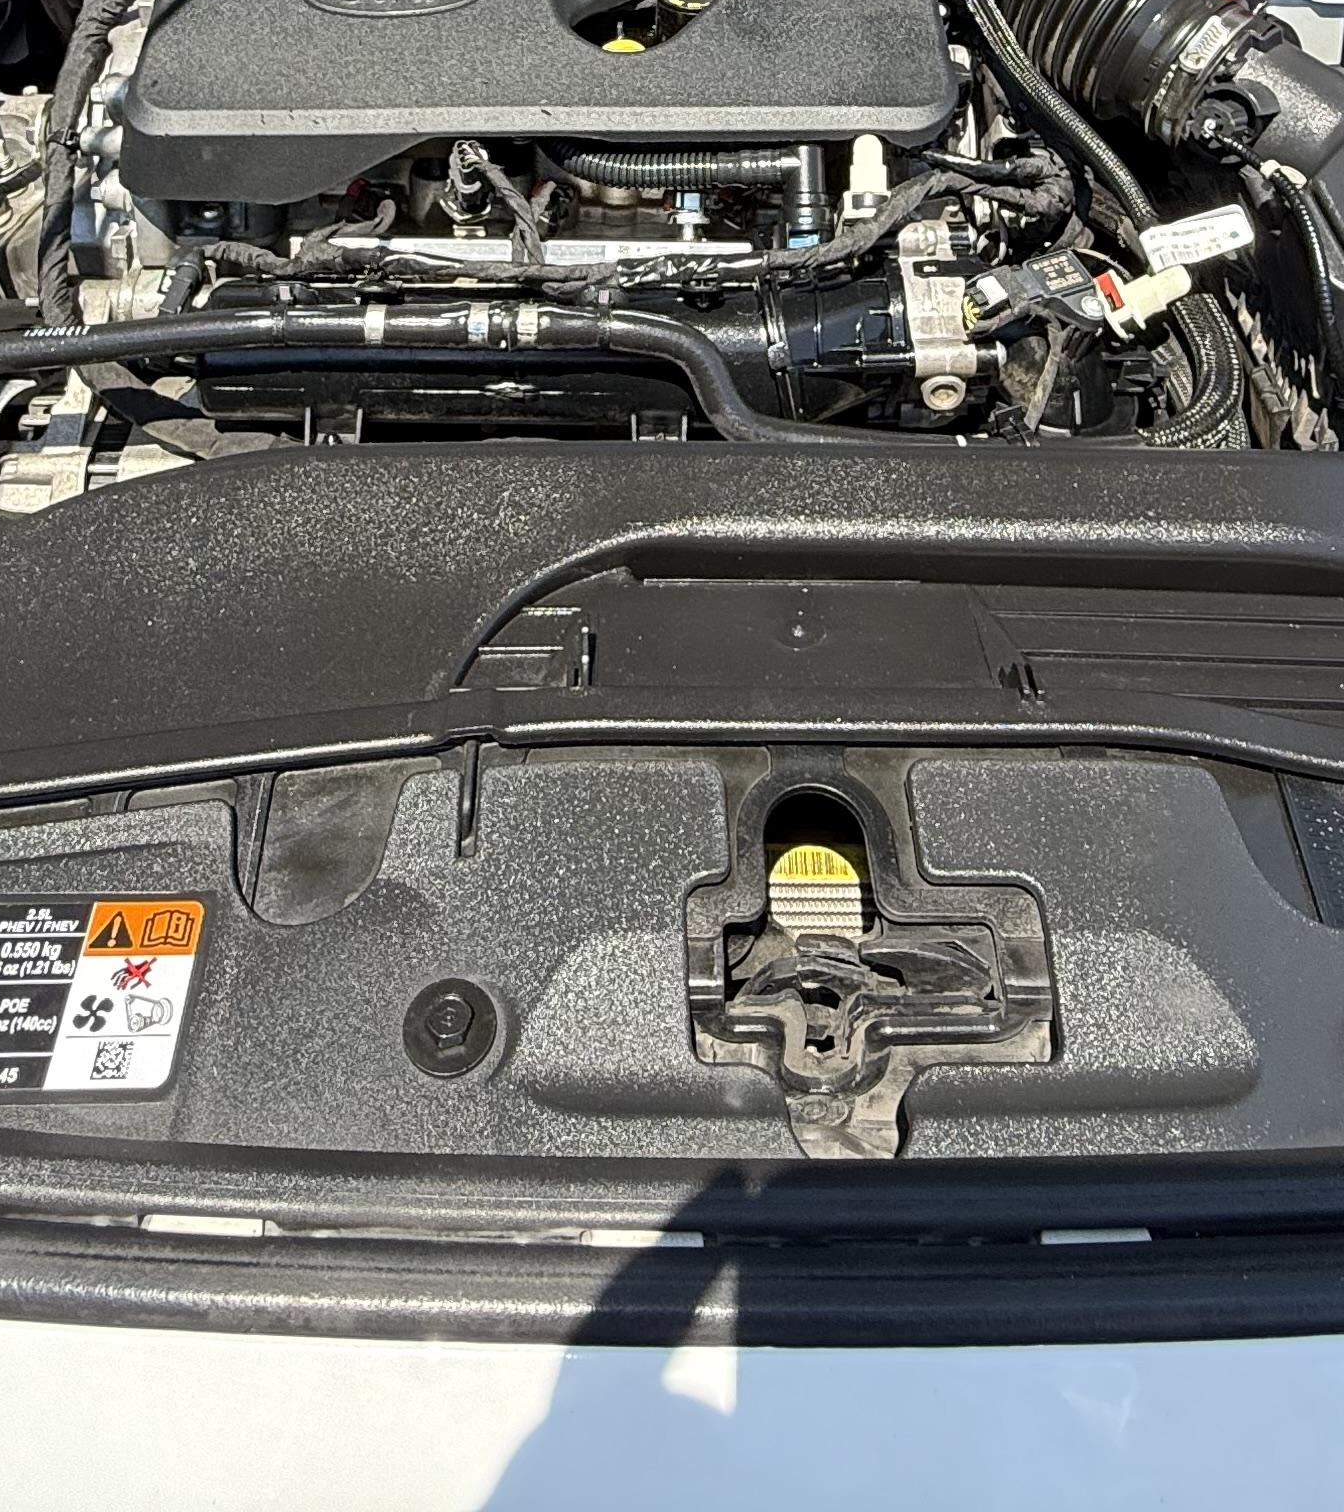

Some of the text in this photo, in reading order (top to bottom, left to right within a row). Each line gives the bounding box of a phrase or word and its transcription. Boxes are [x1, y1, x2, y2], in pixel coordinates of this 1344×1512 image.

[43, 920, 79, 932] FHEV
[0, 942, 62, 960] 0.550 kg
[1, 963, 19, 976] oz
[20, 961, 50, 979] (1.21
[51, 960, 76, 977] lbs)
[0, 999, 30, 1013] POE
[11, 1015, 56, 1035] (140cc)
